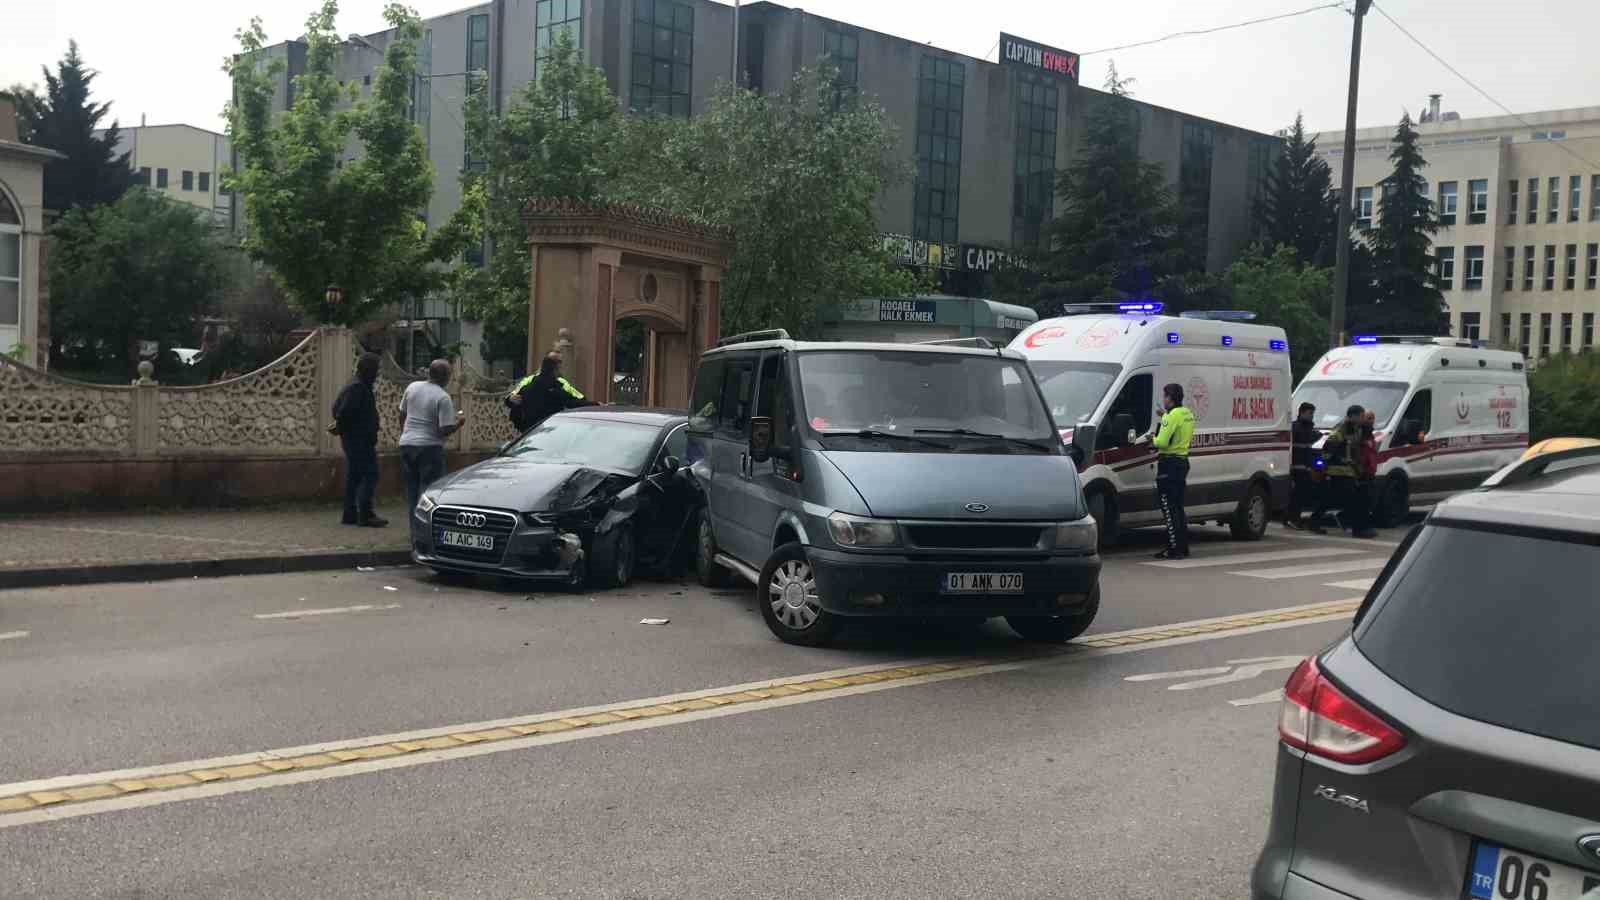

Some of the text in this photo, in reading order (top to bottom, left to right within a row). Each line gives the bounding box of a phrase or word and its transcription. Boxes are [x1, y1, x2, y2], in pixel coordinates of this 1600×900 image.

[1006, 40, 1042, 68] CAPTAIN
[880, 311, 934, 322] HALK EKMEK
[1250, 393, 1275, 420] SAĞLIK
[1496, 410, 1511, 429] 112
[444, 532, 492, 548] 41 AIC 149
[951, 574, 1021, 588] 01 ANK 070
[1472, 856, 1552, 900] TR 06
